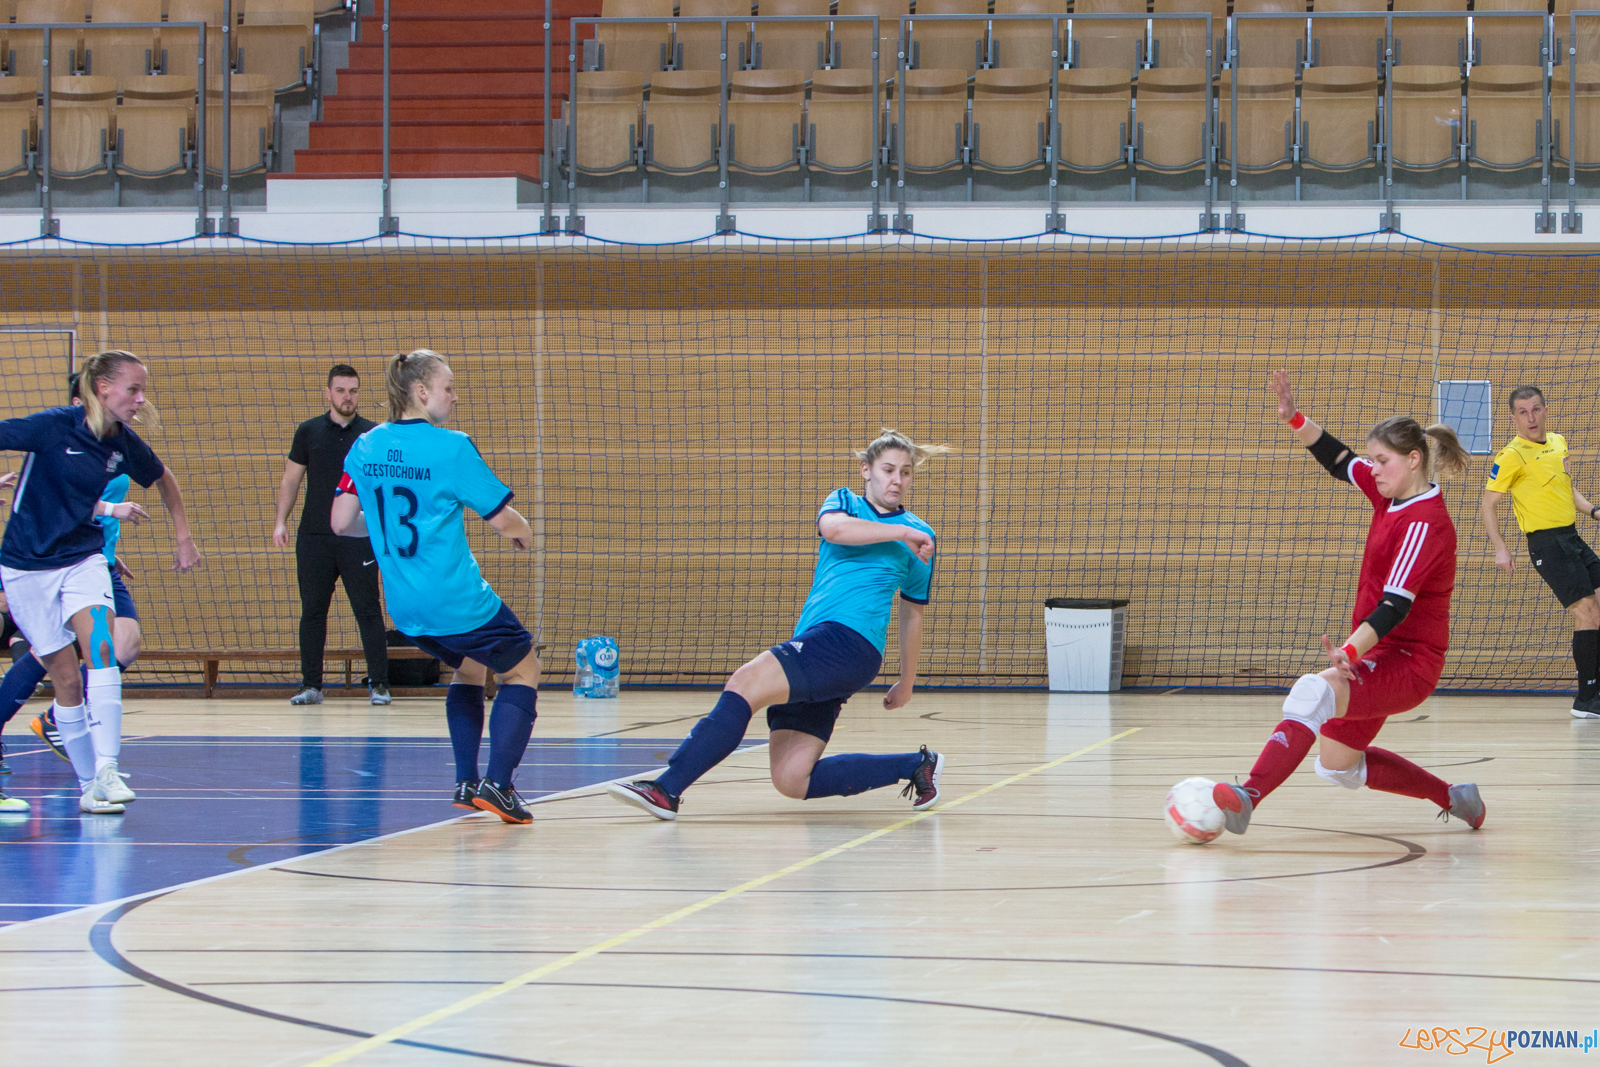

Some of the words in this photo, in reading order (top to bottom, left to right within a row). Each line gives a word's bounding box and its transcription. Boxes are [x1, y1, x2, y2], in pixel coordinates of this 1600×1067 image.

[387, 449, 404, 463] GOL
[362, 463, 431, 481] CZĘSTOCHOWA
[373, 483, 419, 559] 13
